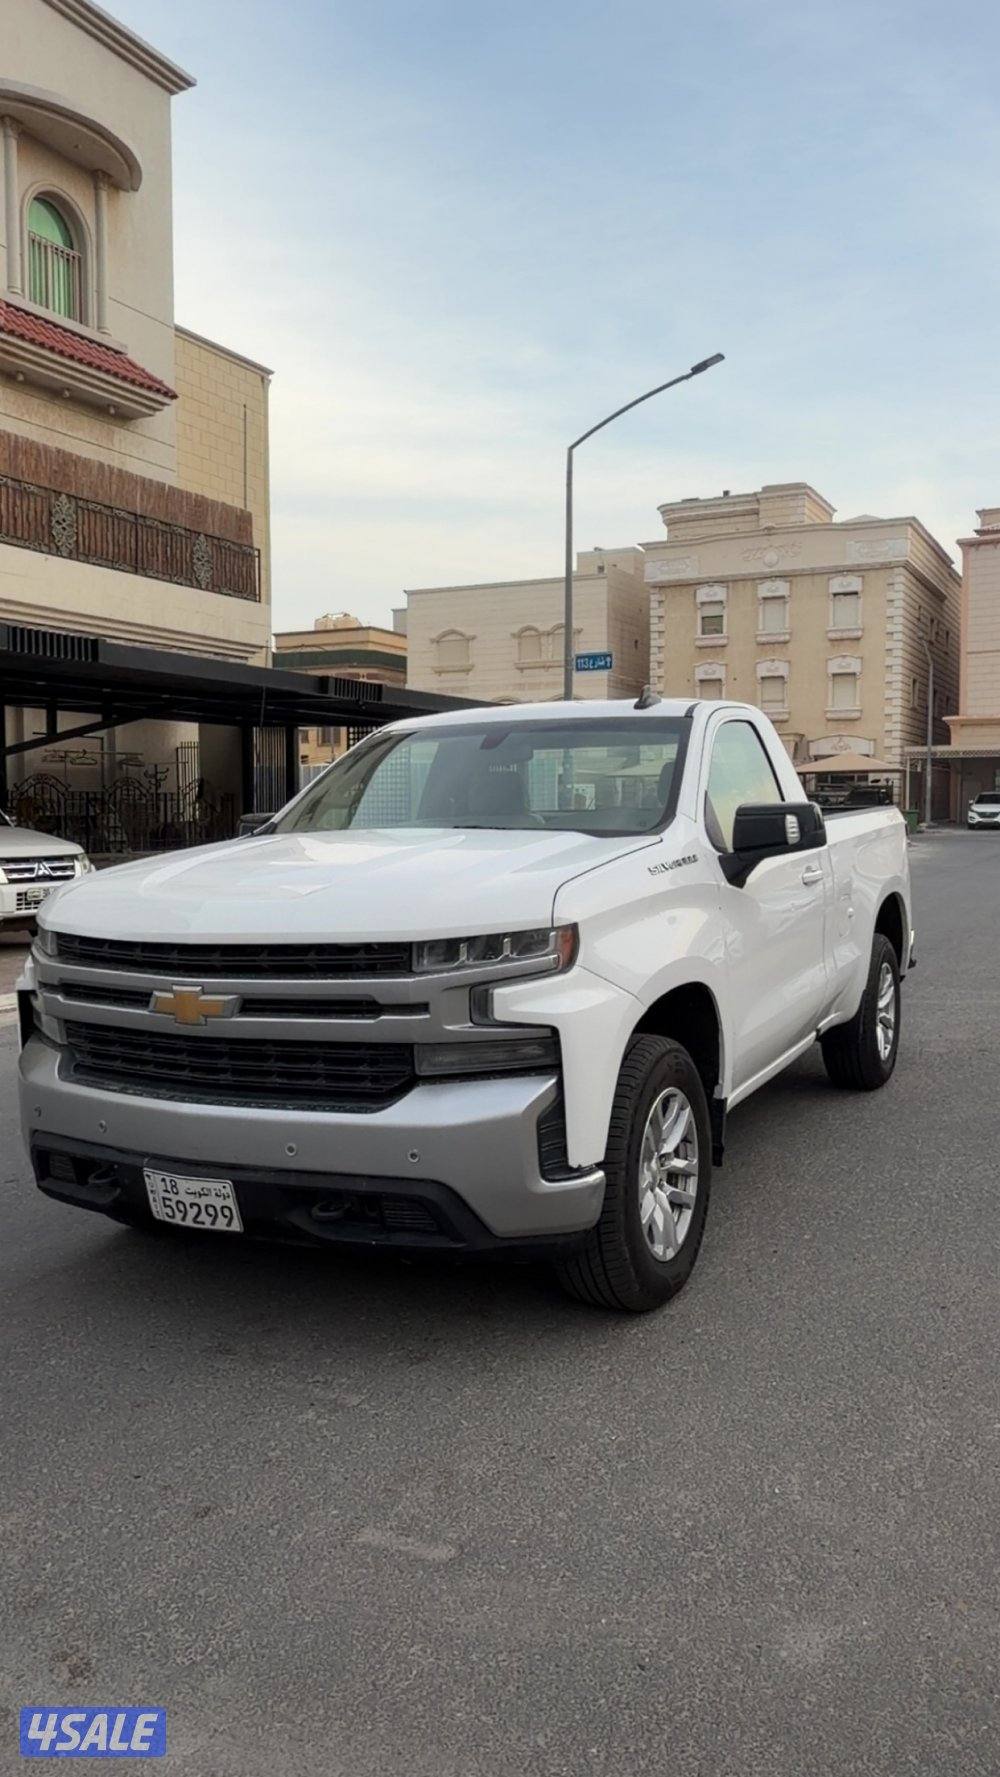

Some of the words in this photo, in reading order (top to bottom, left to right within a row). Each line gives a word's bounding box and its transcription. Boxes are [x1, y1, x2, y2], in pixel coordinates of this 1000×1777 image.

[161, 1178, 179, 1195] 18
[185, 1187, 212, 1199] الكويت
[162, 1196, 234, 1228] 59299
